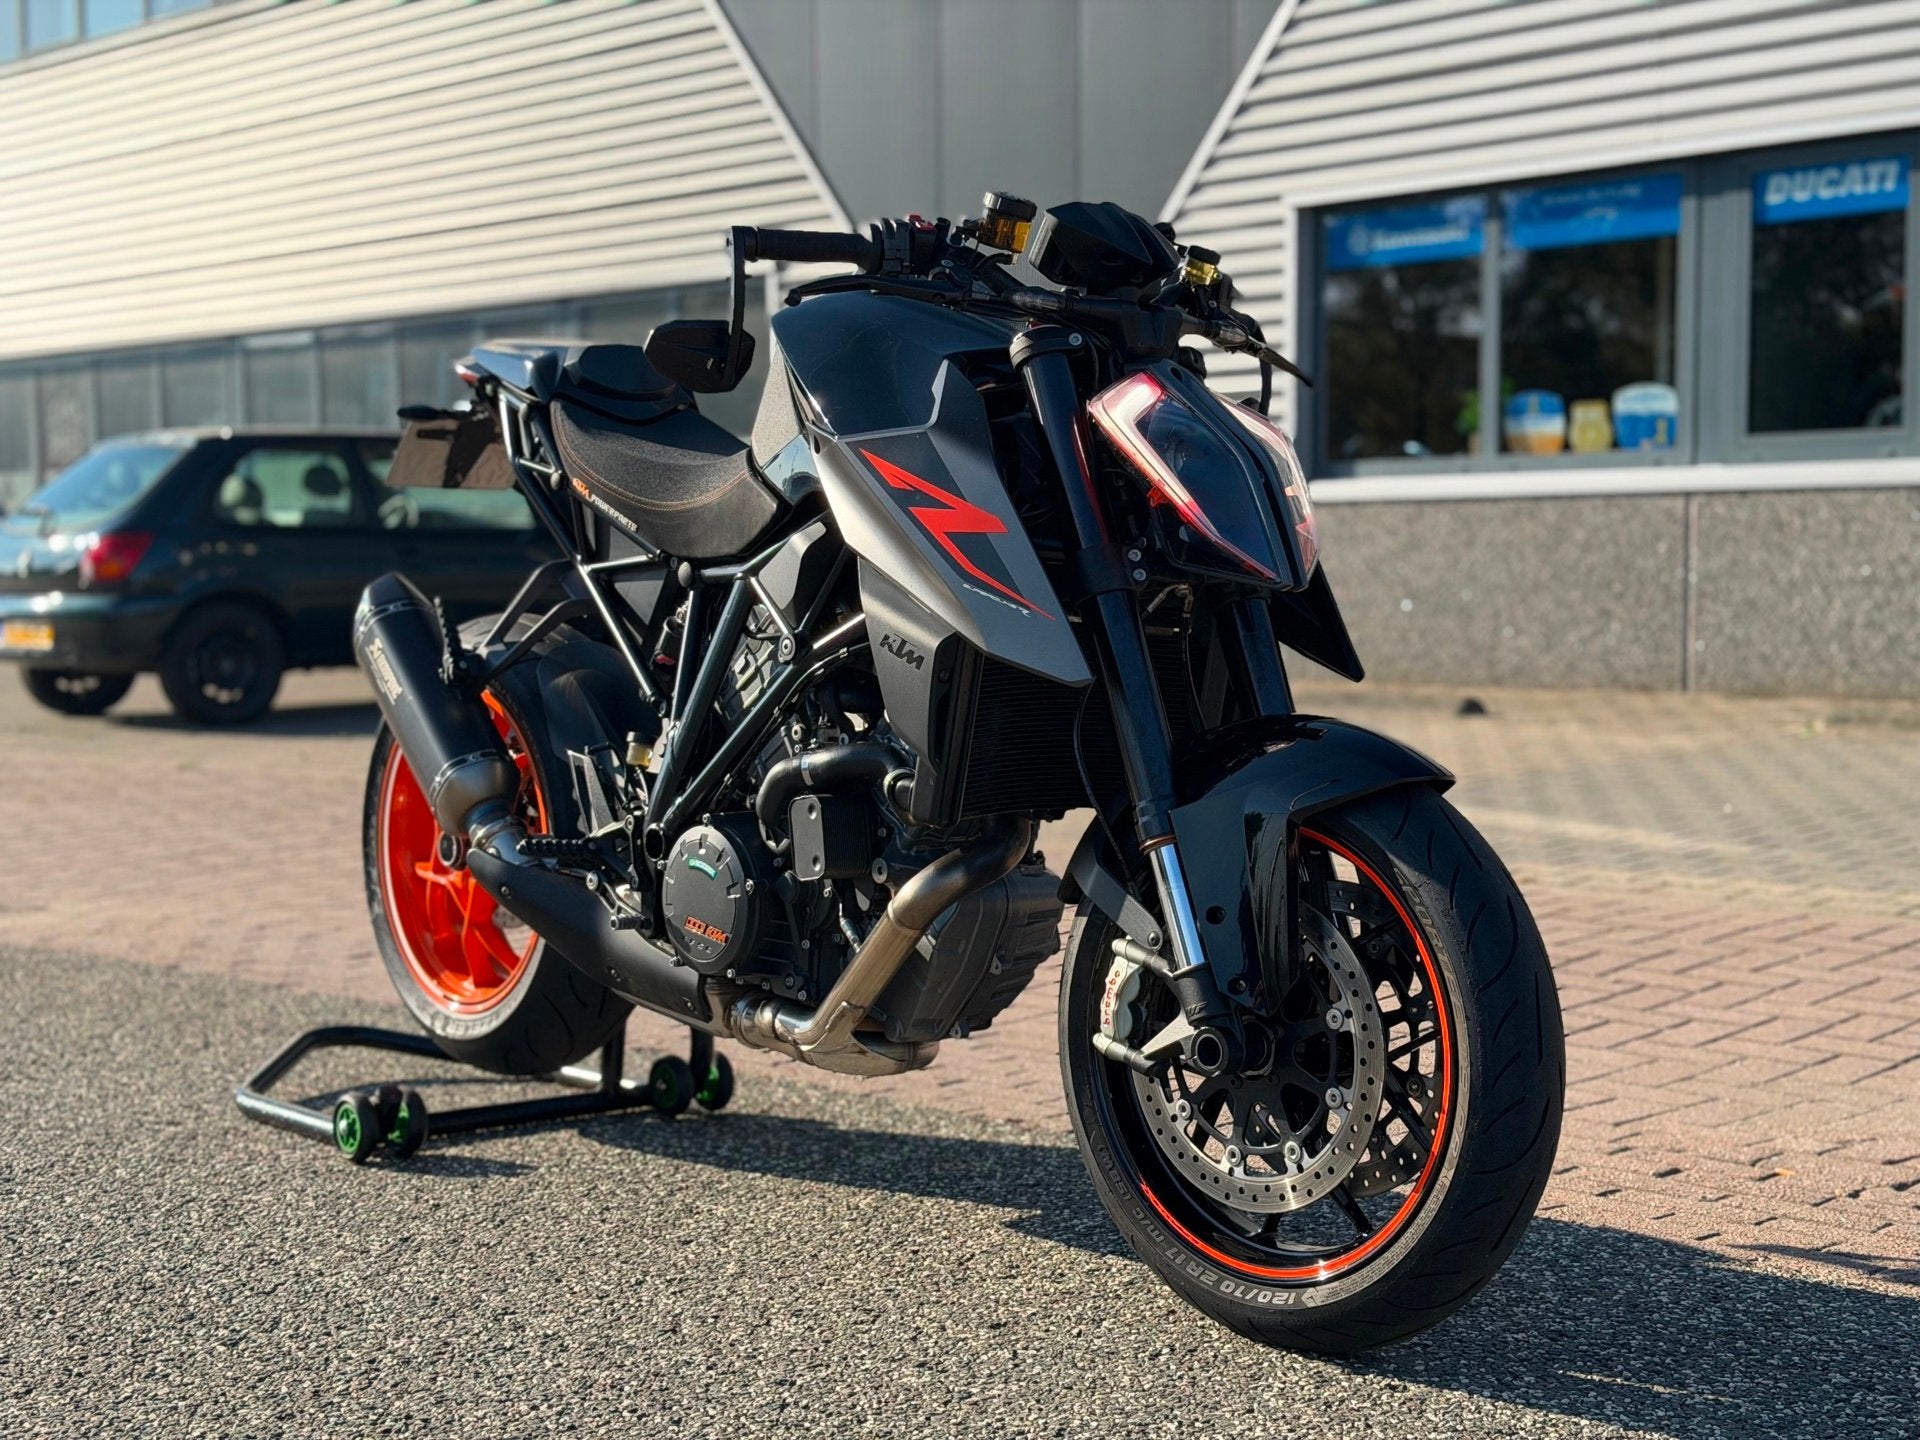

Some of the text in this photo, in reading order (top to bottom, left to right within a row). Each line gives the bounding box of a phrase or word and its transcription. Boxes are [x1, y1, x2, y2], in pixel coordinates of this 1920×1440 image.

[1764, 160, 1899, 206] DUCATI
[879, 632, 925, 671] KTM
[1103, 969, 1121, 1026] brembo
[1163, 1248, 1185, 1266] 17
[1219, 1279, 1297, 1305] 120/70
